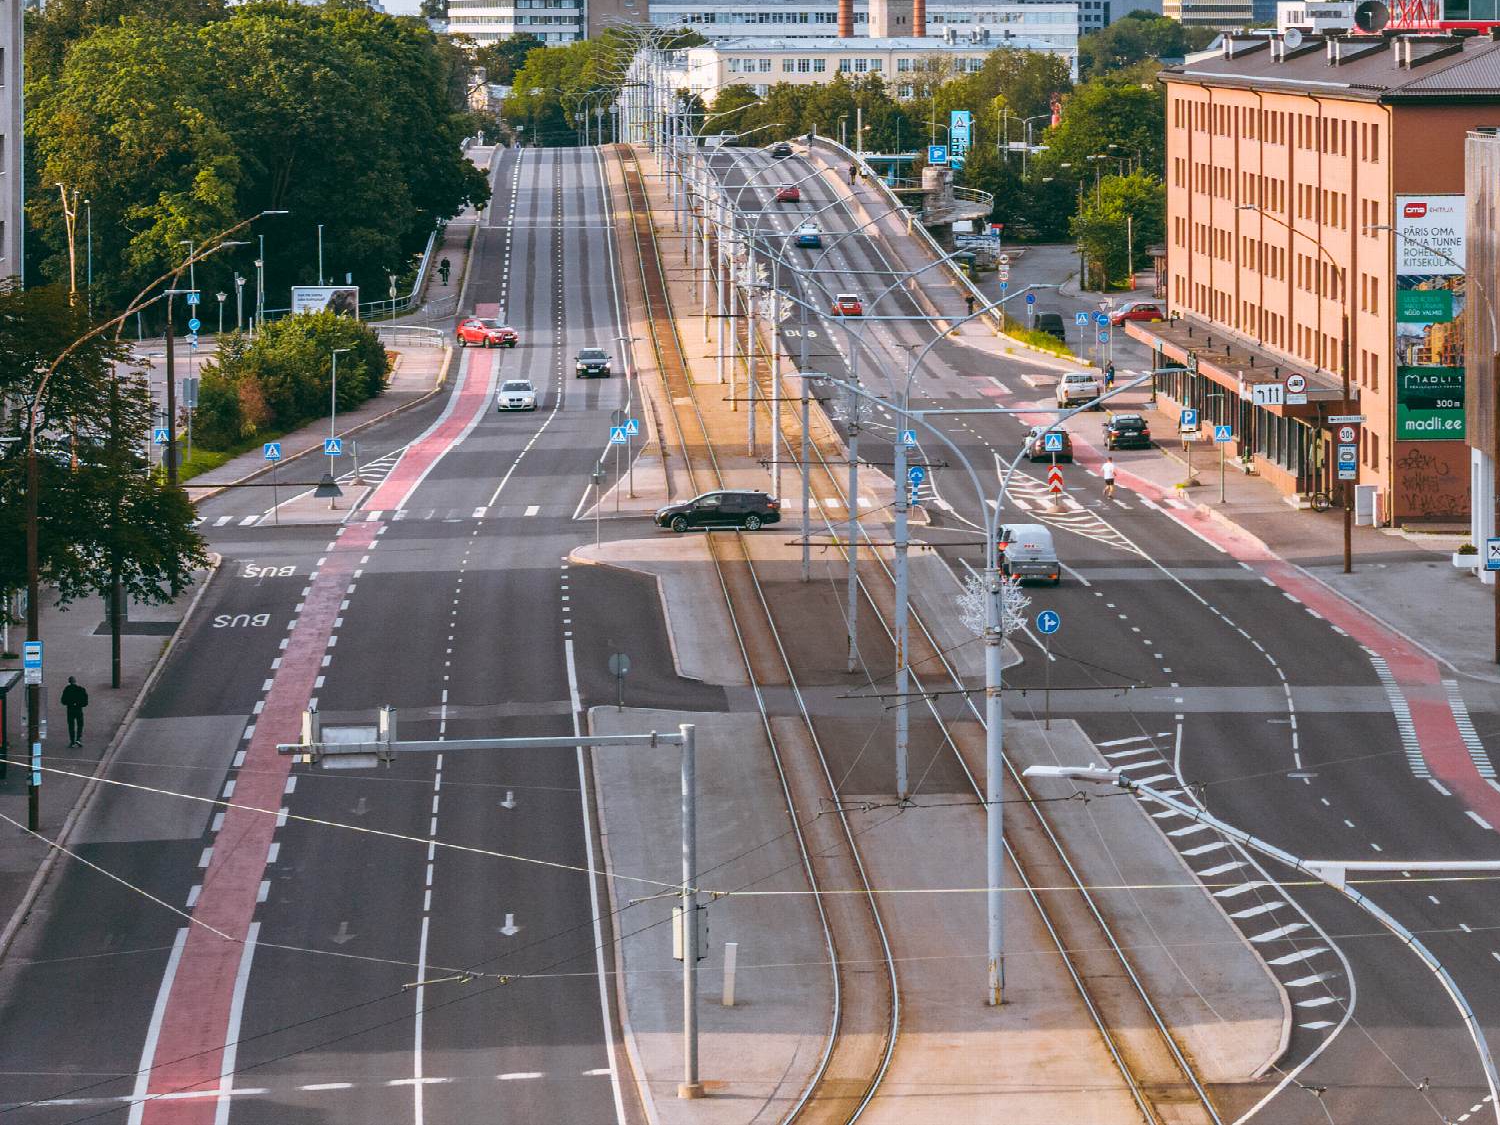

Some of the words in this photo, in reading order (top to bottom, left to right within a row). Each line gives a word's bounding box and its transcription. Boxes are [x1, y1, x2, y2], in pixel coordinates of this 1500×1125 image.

[1403, 225, 1429, 237] PÄRIS
[1430, 227, 1455, 237] OMA
[1403, 237, 1429, 247] MAJA
[1431, 237, 1462, 247] TUNNE
[1436, 399, 1453, 408] 300
[1184, 411, 1193, 424] P
[1404, 416, 1463, 431] madli.ee
[243, 563, 297, 578] BUS
[213, 613, 271, 628] BUS
